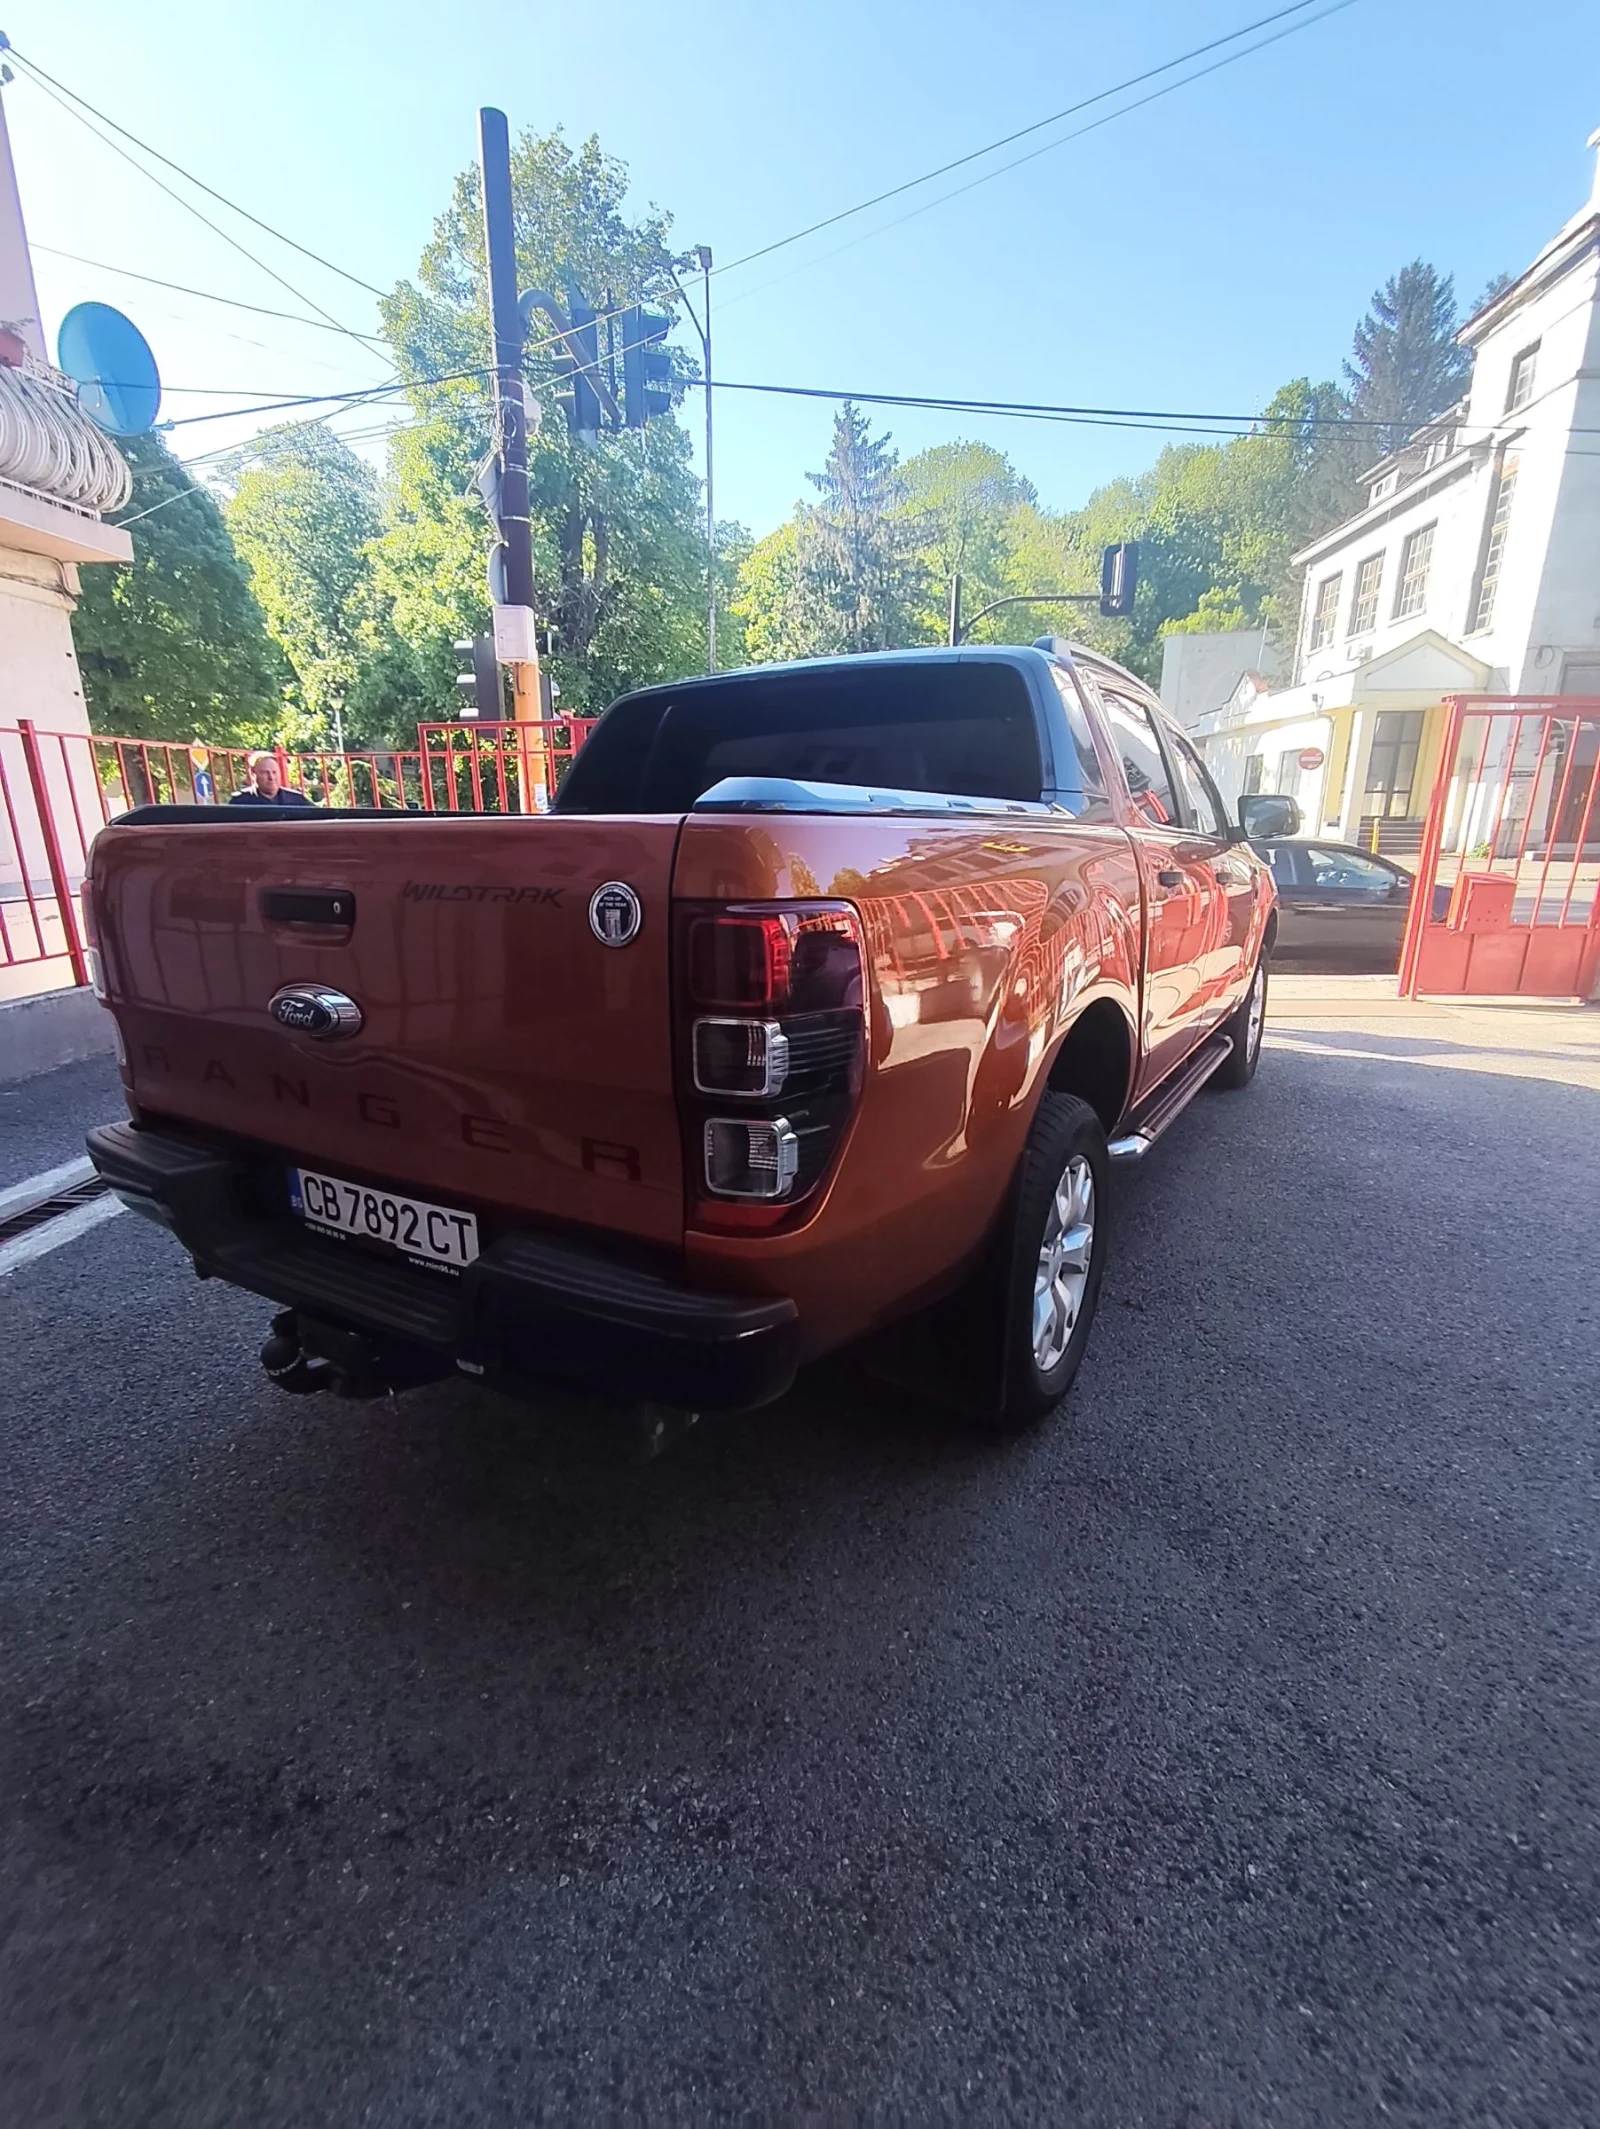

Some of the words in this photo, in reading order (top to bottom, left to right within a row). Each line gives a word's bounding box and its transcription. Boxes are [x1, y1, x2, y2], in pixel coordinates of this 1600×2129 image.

[403, 880, 566, 909] WILDTRAK
[278, 999, 314, 1027] Ford
[143, 1045, 640, 1181] RANGER
